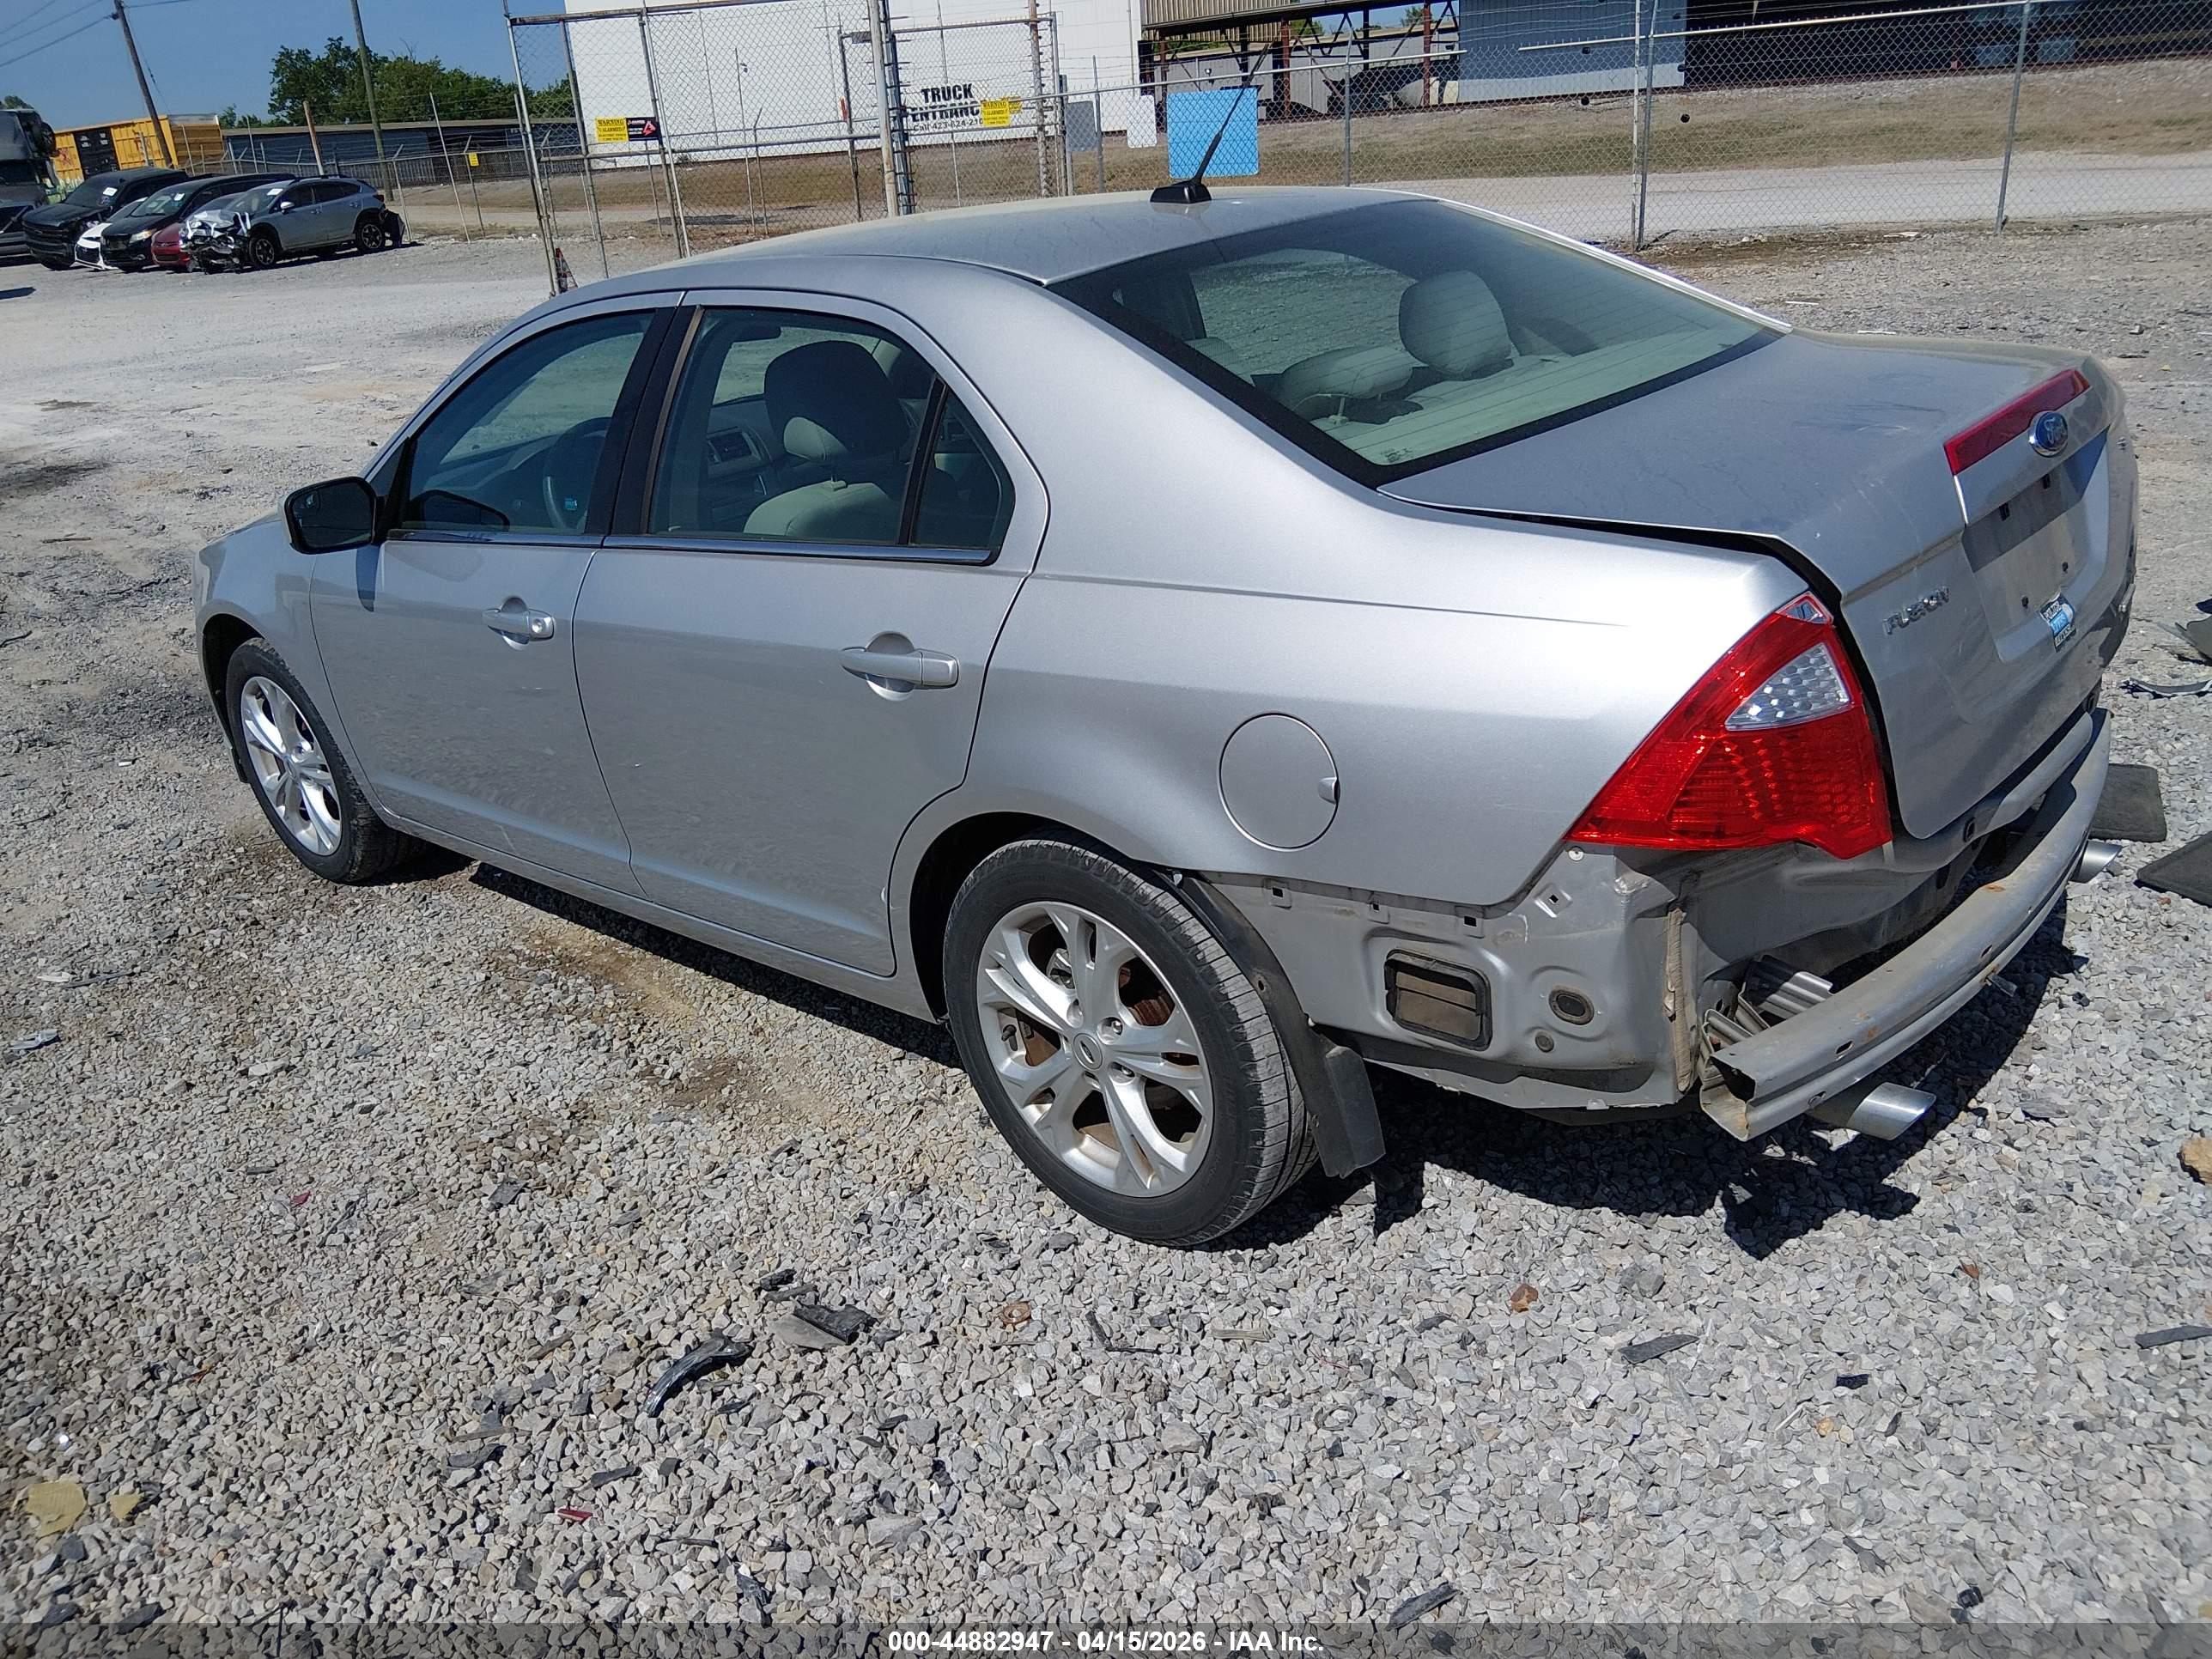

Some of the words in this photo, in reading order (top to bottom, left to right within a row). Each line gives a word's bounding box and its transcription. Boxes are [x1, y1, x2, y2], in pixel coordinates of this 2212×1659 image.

[921, 83, 974, 104] TRUCK
[909, 101, 980, 123] ENTRANC
[981, 100, 1007, 109] WARNING
[913, 123, 929, 132] Call
